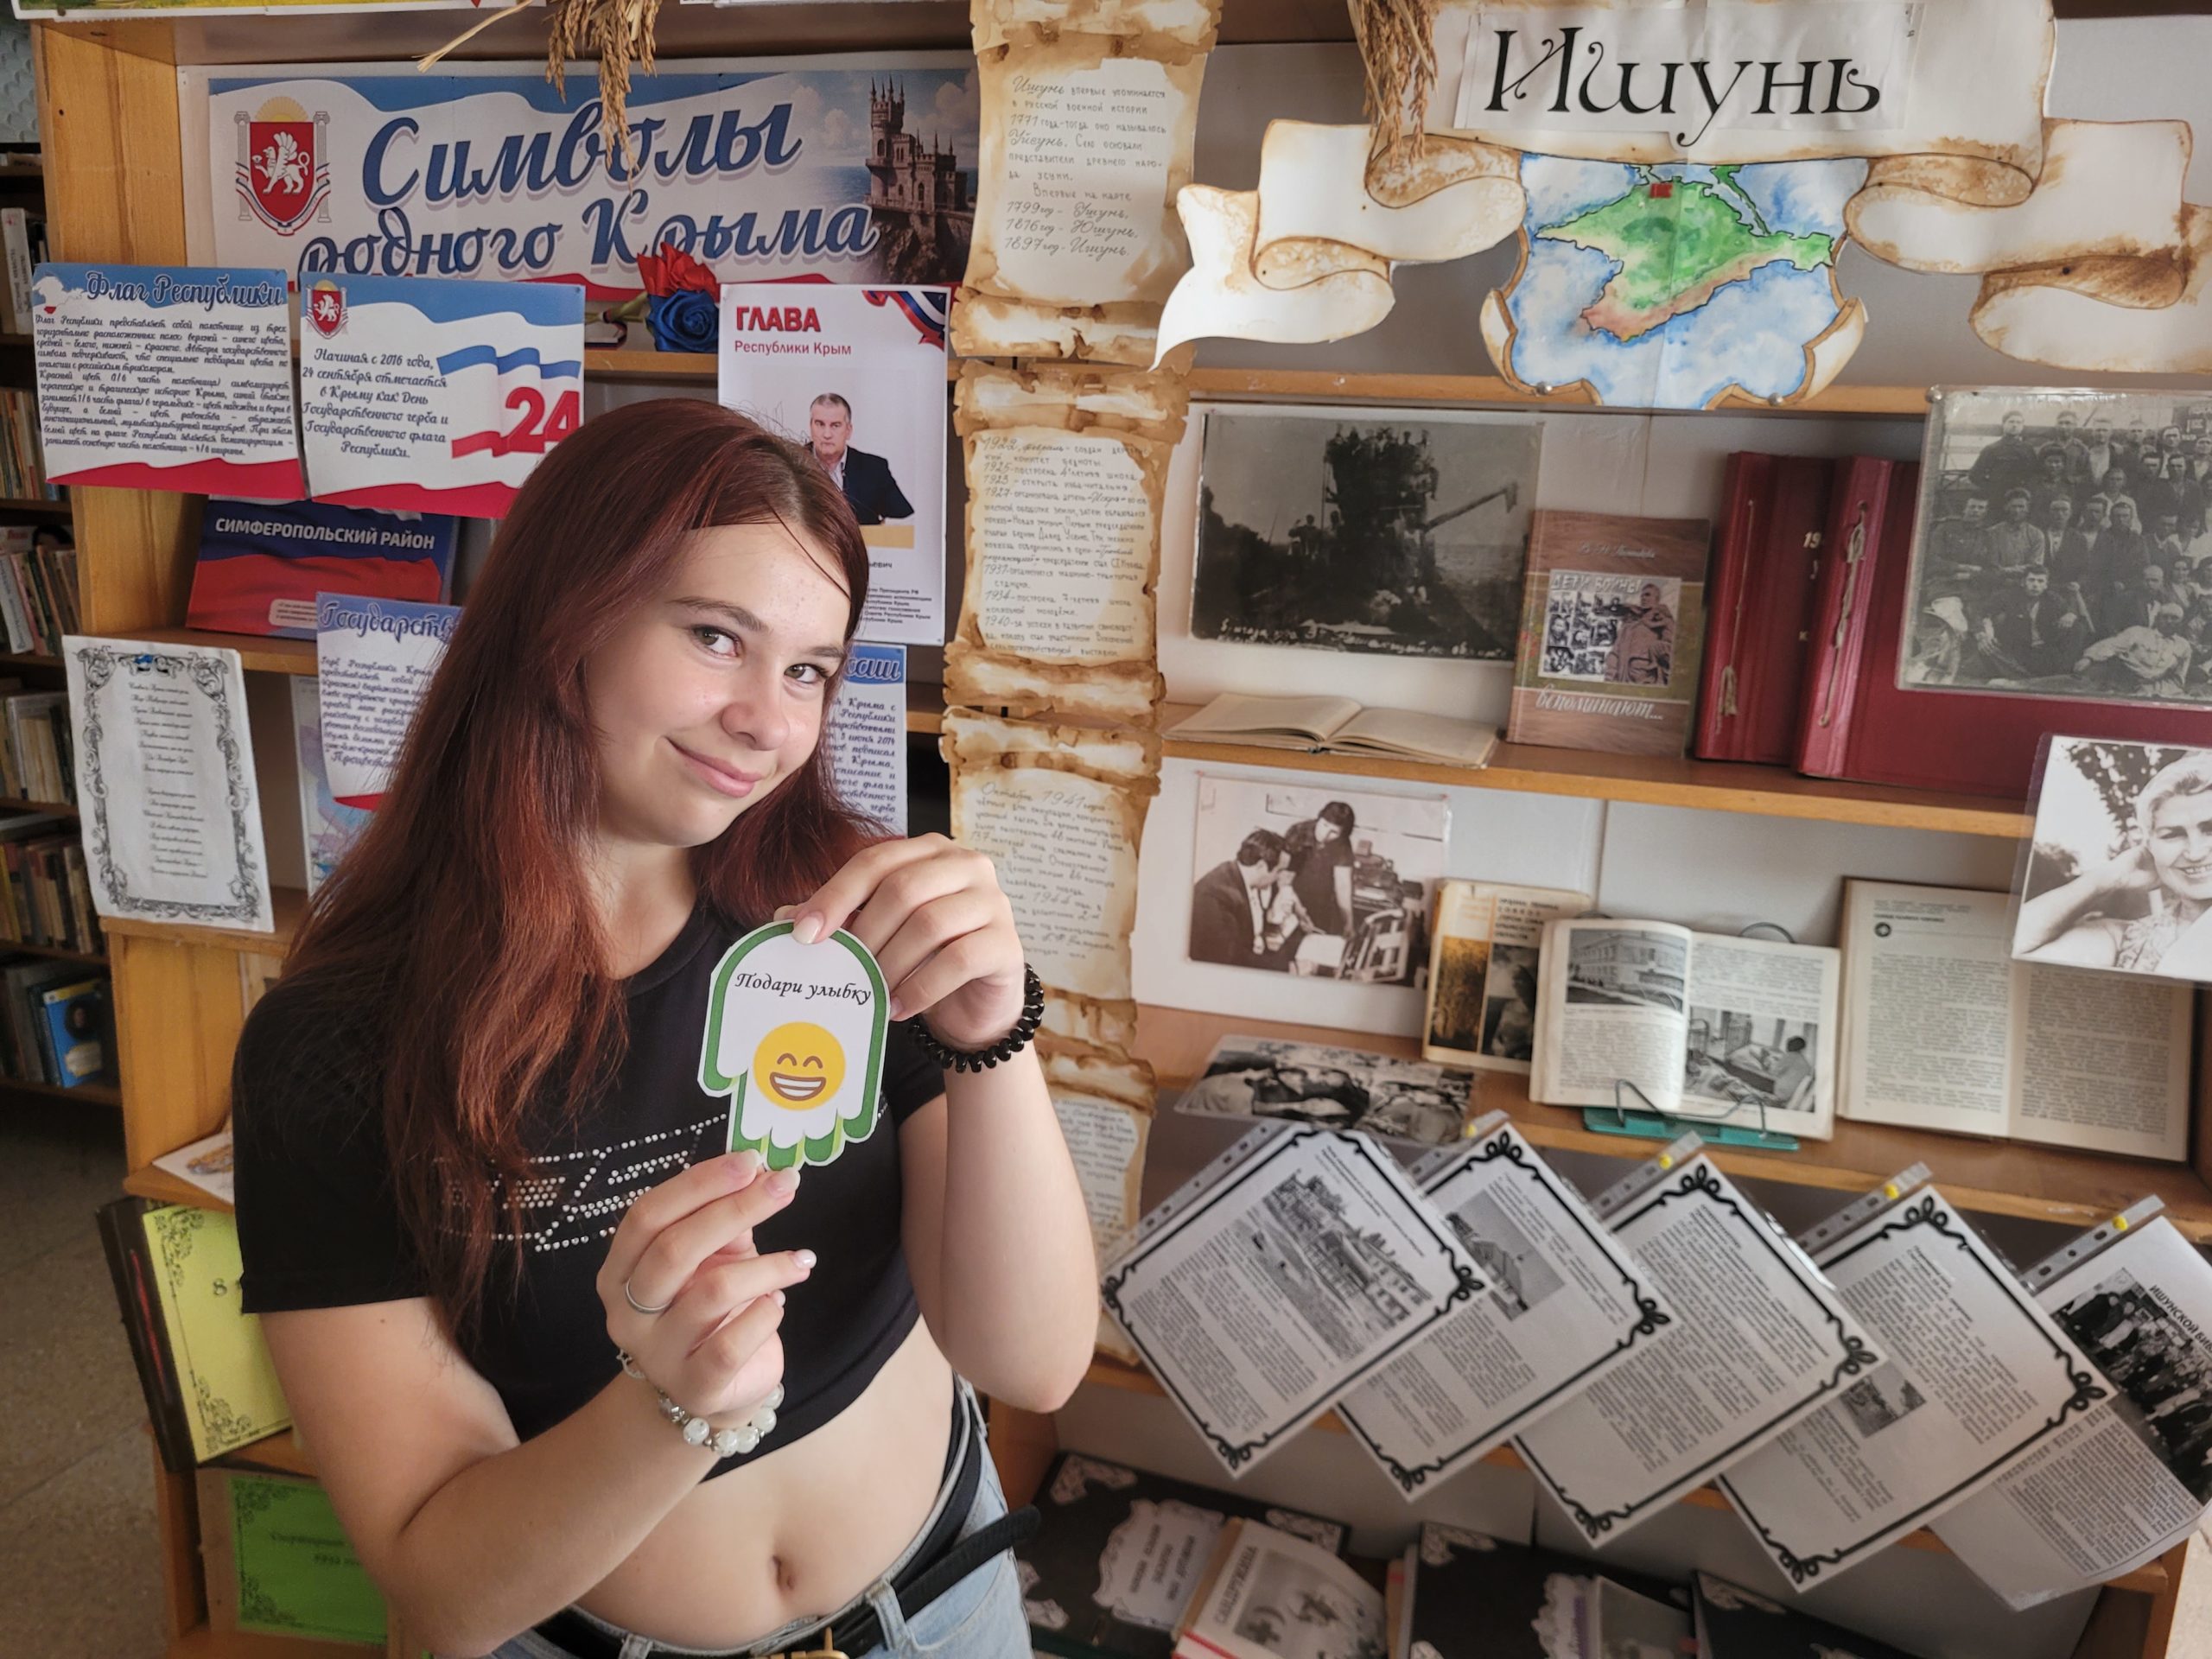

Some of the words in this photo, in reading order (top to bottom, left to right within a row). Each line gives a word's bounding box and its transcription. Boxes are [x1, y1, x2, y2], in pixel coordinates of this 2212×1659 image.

[1012, 75, 1065, 99] Ишунь
[1484, 25, 1882, 148] Ишунь
[361, 100, 802, 206] Символы
[299, 207, 563, 283] родного
[582, 194, 880, 265] Крыма
[86, 271, 149, 303] Флаг
[154, 274, 283, 311] Республики
[735, 306, 821, 333] ГЛАВА
[315, 347, 368, 364] Начиная
[380, 353, 403, 366] 2016
[735, 340, 810, 357] Республики
[813, 341, 852, 356] Крым
[317, 368, 372, 385] сентября
[375, 373, 448, 389] отмечается
[330, 386, 373, 404] Крыму
[376, 391, 398, 403] как
[402, 392, 429, 405] День
[302, 402, 404, 423] Государственного
[406, 410, 437, 426] герба
[505, 386, 580, 453] 24
[305, 420, 407, 442] Государственного
[410, 432, 446, 445] флага
[216, 517, 378, 545] СИМФЕРОПОЛЬСКИЙ
[380, 528, 436, 550] РАЙОН
[734, 973, 803, 998] Подари
[805, 982, 872, 1006] улыбку
[2149, 1283, 2200, 1335] ИШУНСКОЙ
